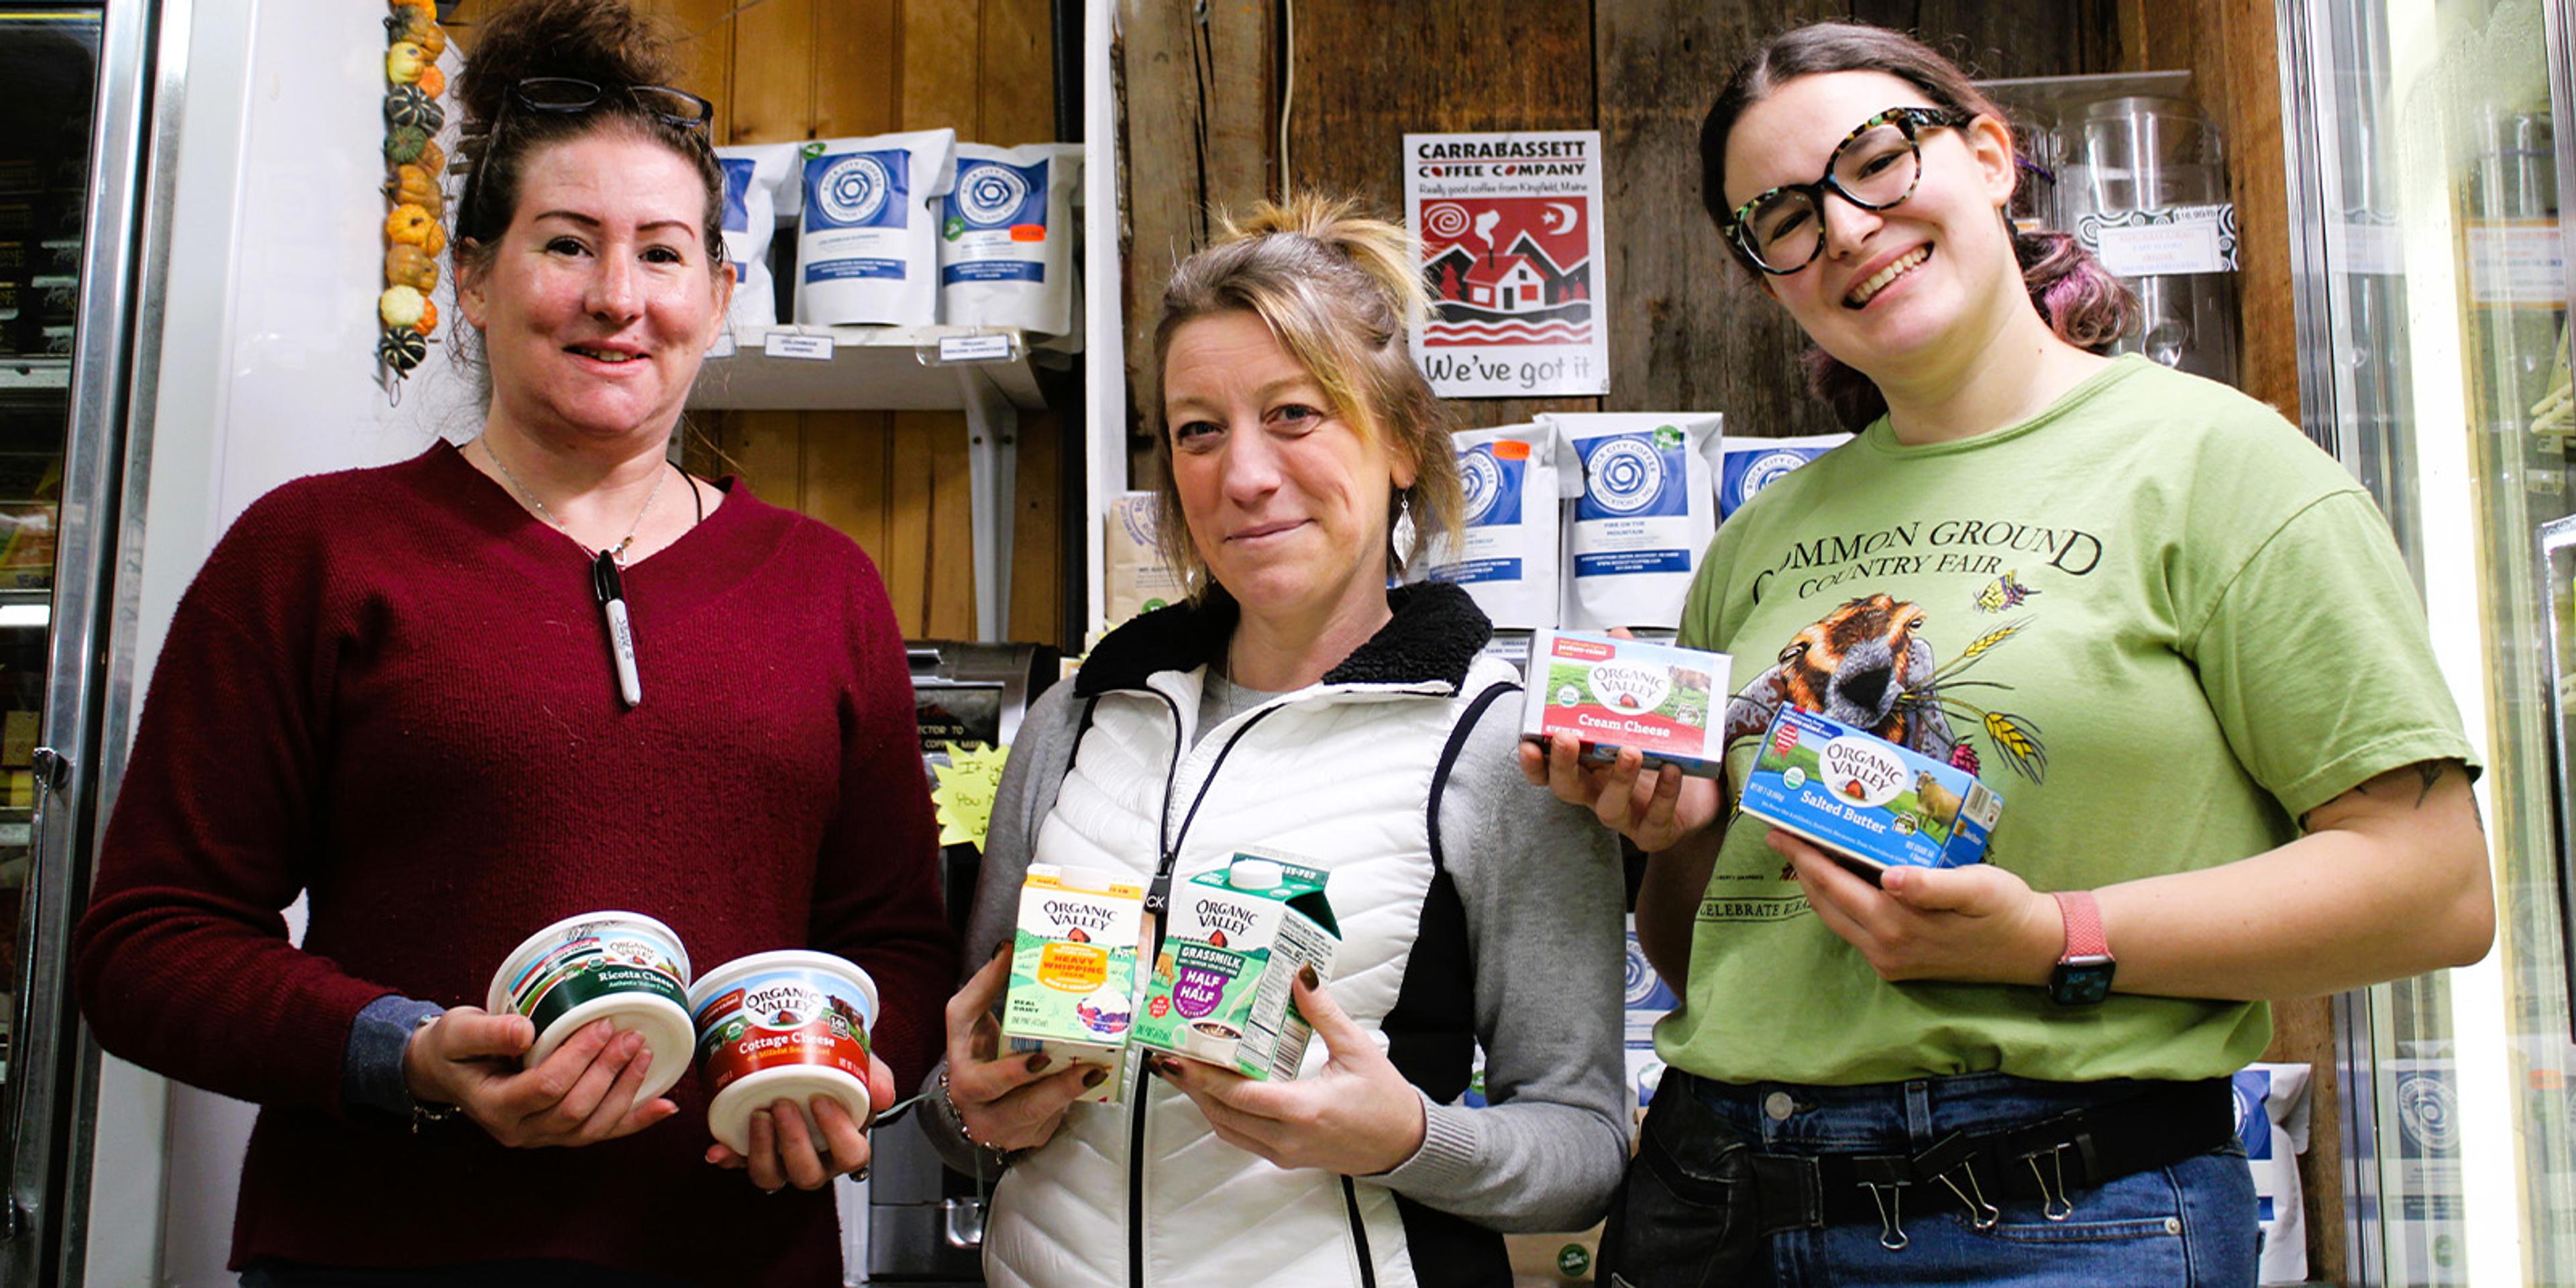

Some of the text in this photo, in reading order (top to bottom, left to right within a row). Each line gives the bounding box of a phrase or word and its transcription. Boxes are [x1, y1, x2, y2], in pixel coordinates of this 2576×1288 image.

[1418, 141, 1585, 158] CARRABASSETT
[1418, 164, 1585, 178] COFFEE COMPANY
[1419, 184, 1446, 195] Really
[1448, 184, 1468, 195] good
[1470, 184, 1497, 193] coffee
[1499, 183, 1517, 192] from
[1561, 182, 1587, 191] Maine
[1426, 354, 1591, 389] We've got it
[1607, 443, 1628, 453] CITY
[1630, 443, 1656, 472] COFFEE
[1764, 457, 1784, 468] CITY
[1929, 521, 2102, 576] GROUND
[1799, 553, 2003, 599] COUNTRY FAIR
[1593, 667, 1666, 691] ORGANIC
[1601, 680, 1658, 698] VALLEY
[951, 725, 964, 735] TO
[1578, 714, 1671, 737] Cream Cheese
[1827, 743, 1903, 784] ORGANIC
[1831, 761, 1890, 792] VALLEY
[1801, 790, 1841, 817] Salted
[1843, 807, 1887, 835] Butter
[1043, 900, 1118, 922] ORGANIC
[1146, 894, 1165, 909] CK
[1049, 914, 1110, 931] VALLEY
[1196, 899, 1259, 926] ORGANIC
[1199, 914, 1249, 936] VALLEY
[1043, 962, 1104, 975] WHIPPING
[1054, 955, 1095, 965] HEAVY
[1181, 947, 1242, 970] GRASSMILK
[598, 970, 675, 990] Ricotta Cheese
[1186, 971, 1220, 988] HALF
[745, 987, 820, 1009] ORGANIC
[1180, 985, 1215, 1004] HALF
[755, 999, 809, 1016] VALLEY
[739, 1032, 835, 1055] Cottage Cheese
[758, 1047, 788, 1059] Milkfat
